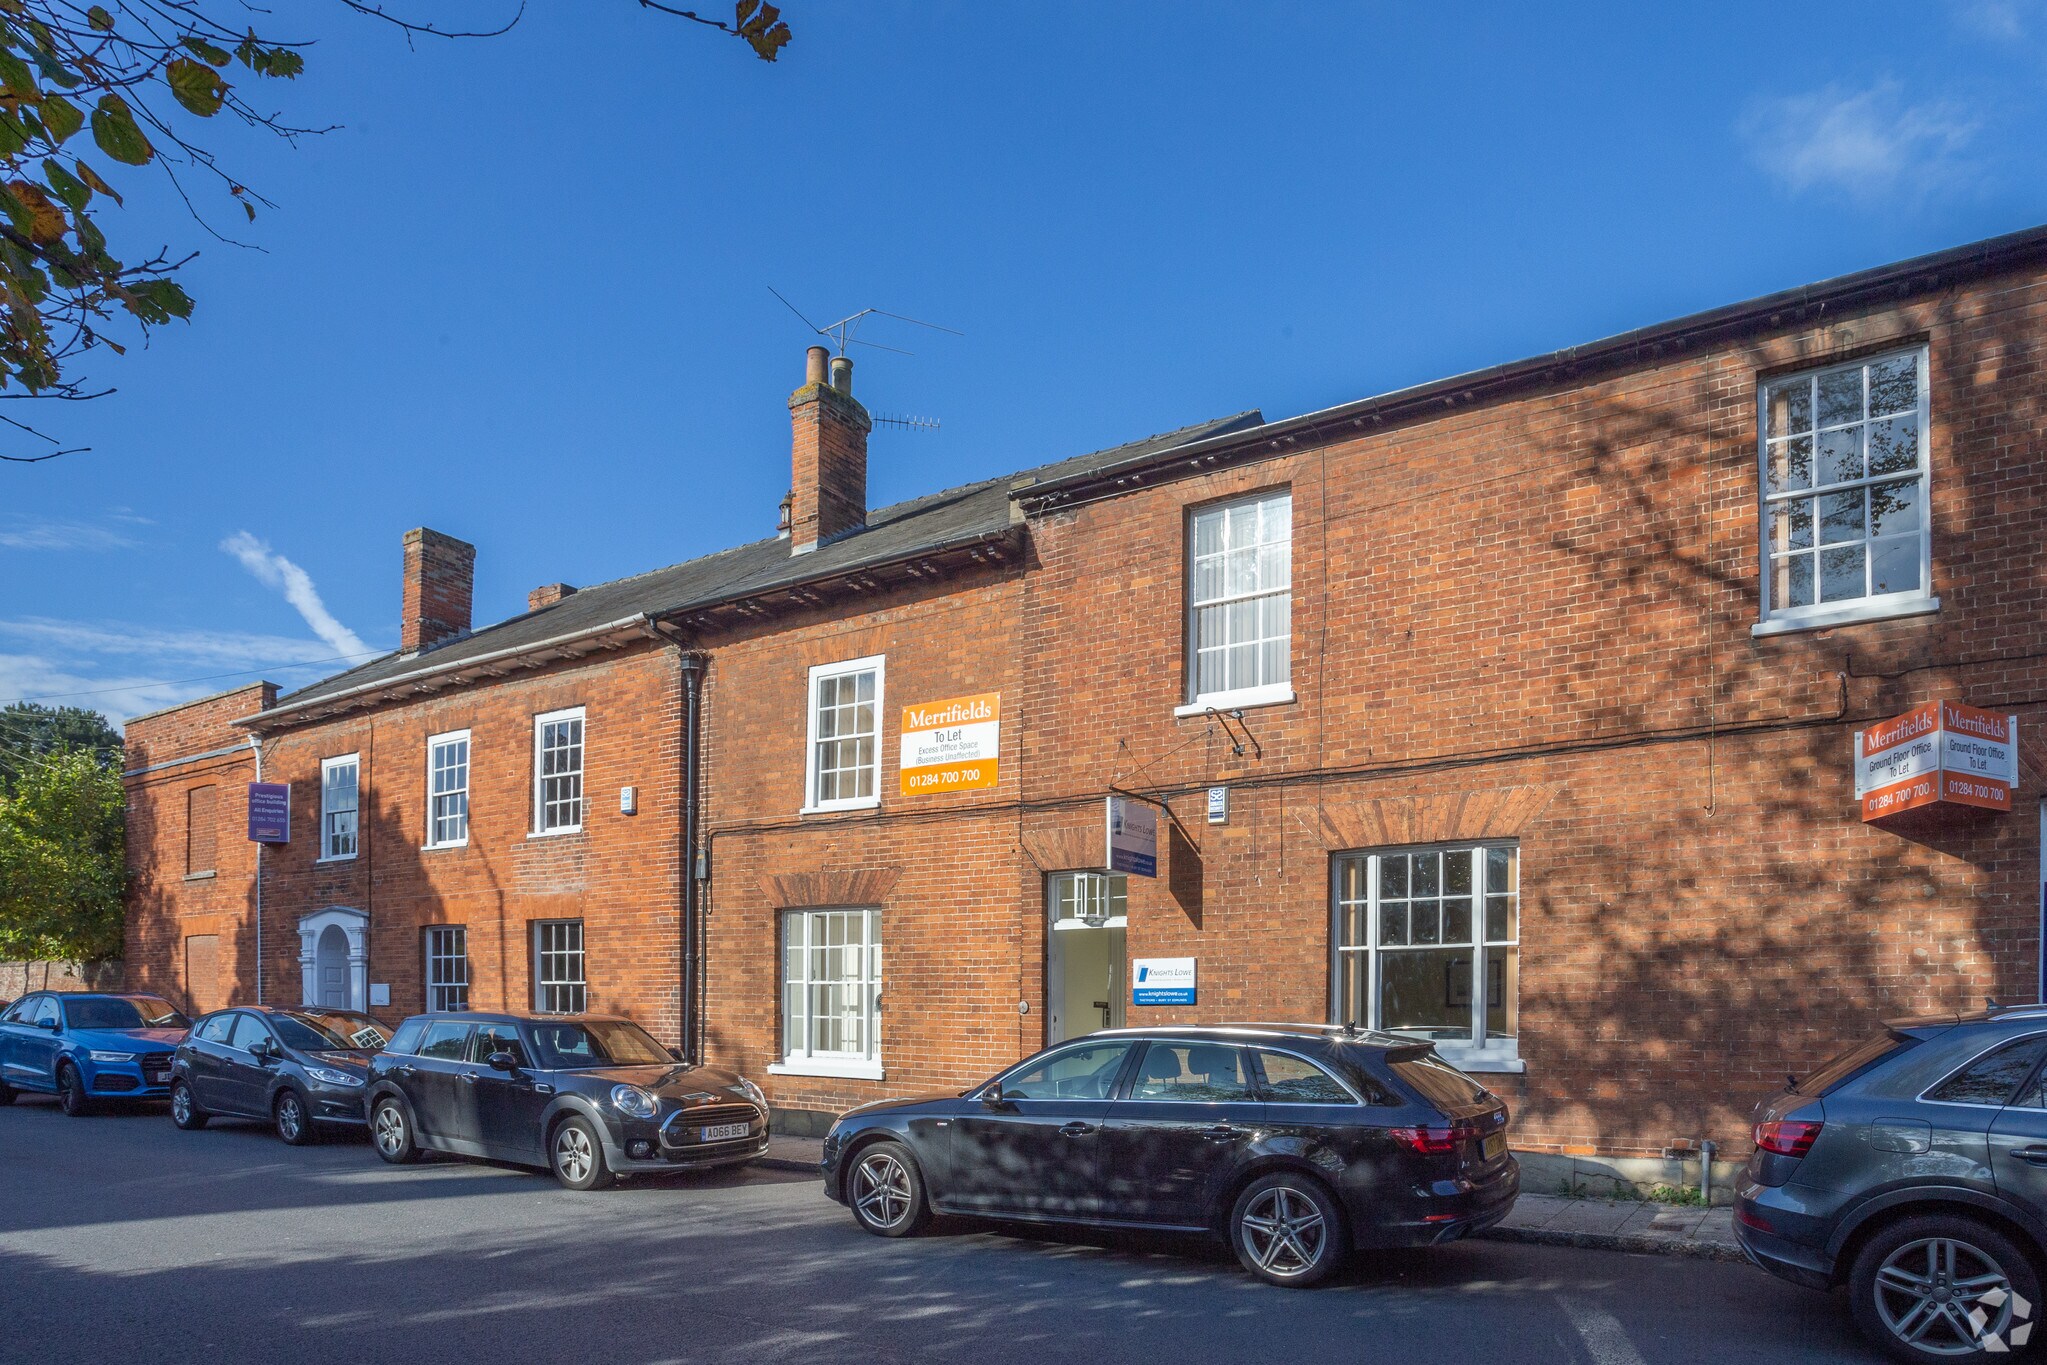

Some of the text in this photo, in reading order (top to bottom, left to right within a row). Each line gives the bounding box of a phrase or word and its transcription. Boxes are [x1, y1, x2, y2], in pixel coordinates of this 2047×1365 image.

[909, 700, 992, 728] Merrifields
[1948, 707, 2005, 738] Merrifields
[935, 729, 962, 743] To Let
[1868, 711, 1933, 751] Merrifields
[916, 749, 981, 765] (Business Unaffected)
[918, 741, 979, 755] Excess Office Space
[1869, 742, 1932, 772] Ground Floor Office
[1949, 739, 2005, 759] Ground Floor Office
[1889, 763, 1910, 778] To Let
[1969, 756, 1987, 770] To Let
[909, 769, 980, 787] 01284 700 700
[1869, 782, 1930, 811] 01284 700 700
[1949, 780, 2004, 801] 01284 700 700
[1124, 819, 1142, 833] KNIGHTS
[1143, 825, 1156, 837] LOWE
[732, 1124, 747, 1135] BEY
